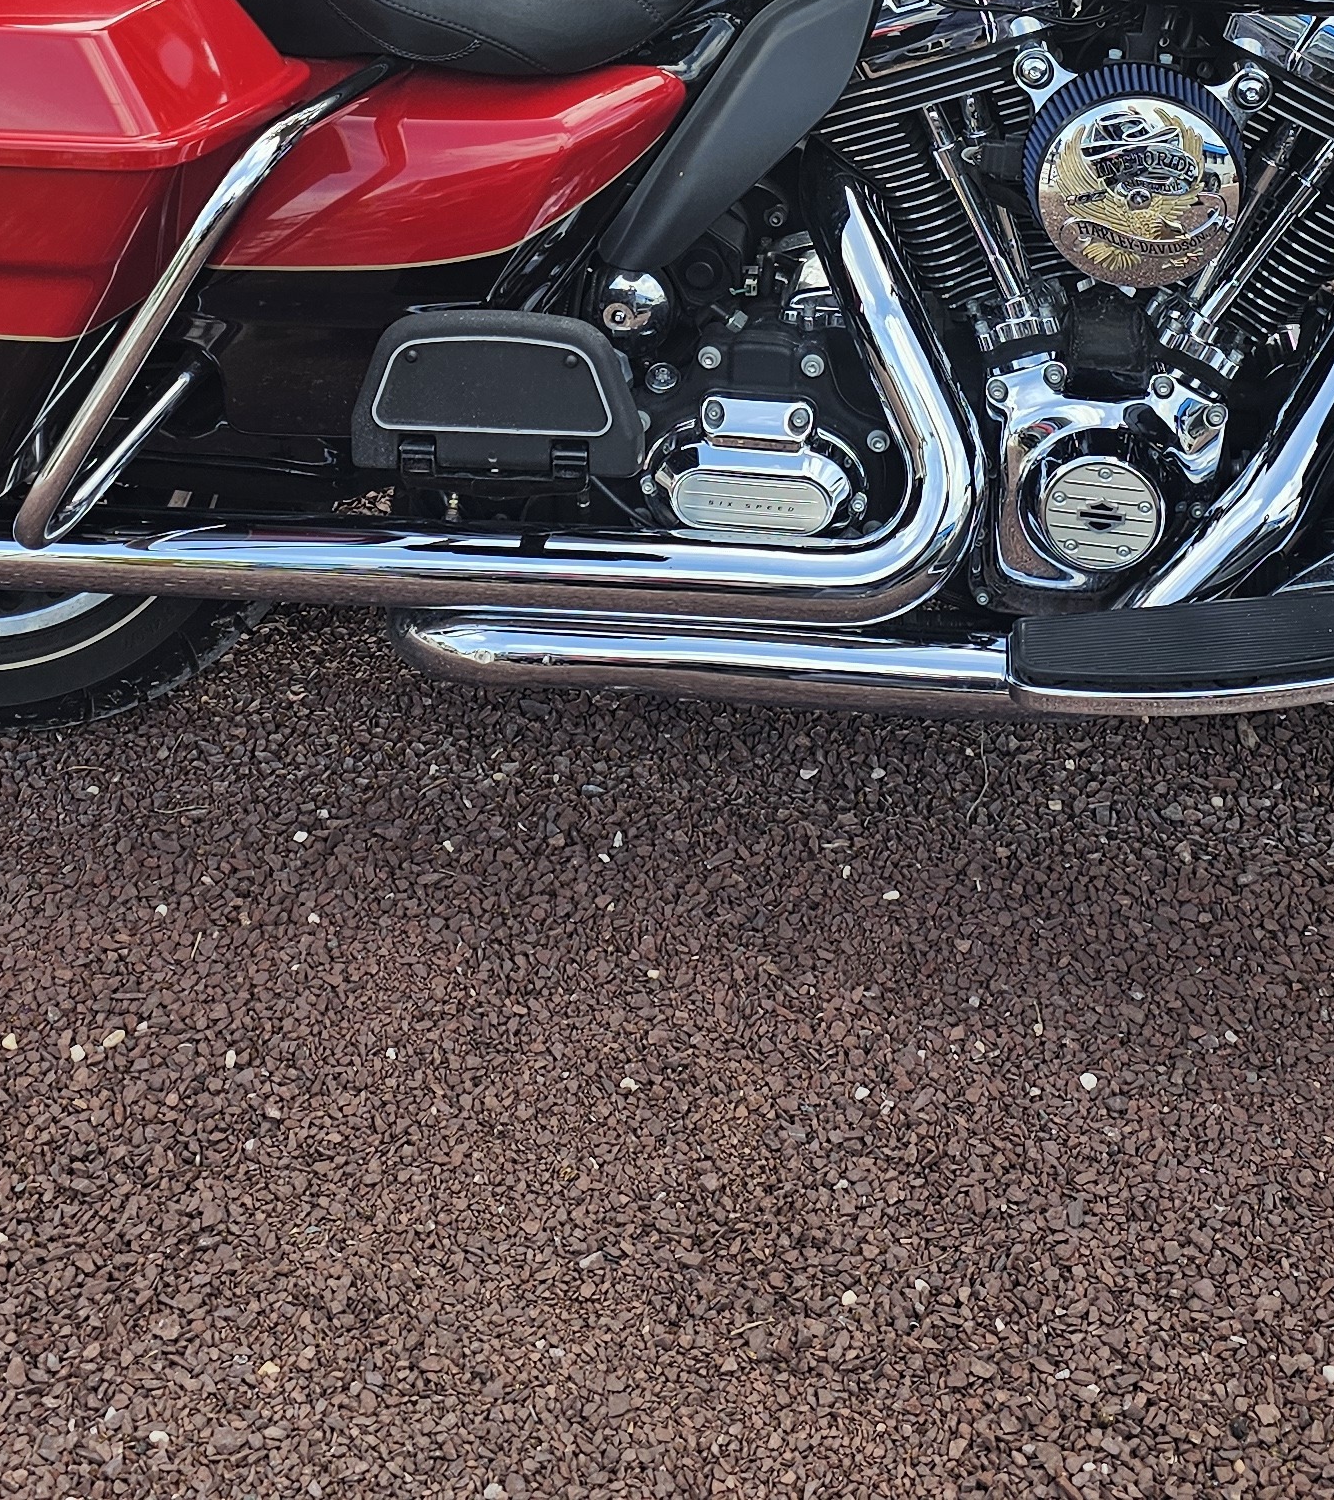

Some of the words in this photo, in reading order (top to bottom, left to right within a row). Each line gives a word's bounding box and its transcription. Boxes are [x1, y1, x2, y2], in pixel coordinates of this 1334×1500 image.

[1095, 154, 1134, 179] LIVE
[1156, 150, 1197, 182] RIDE
[1076, 221, 1207, 255] HARLEY-DAVIDSON
[745, 503, 795, 512] SPEED
